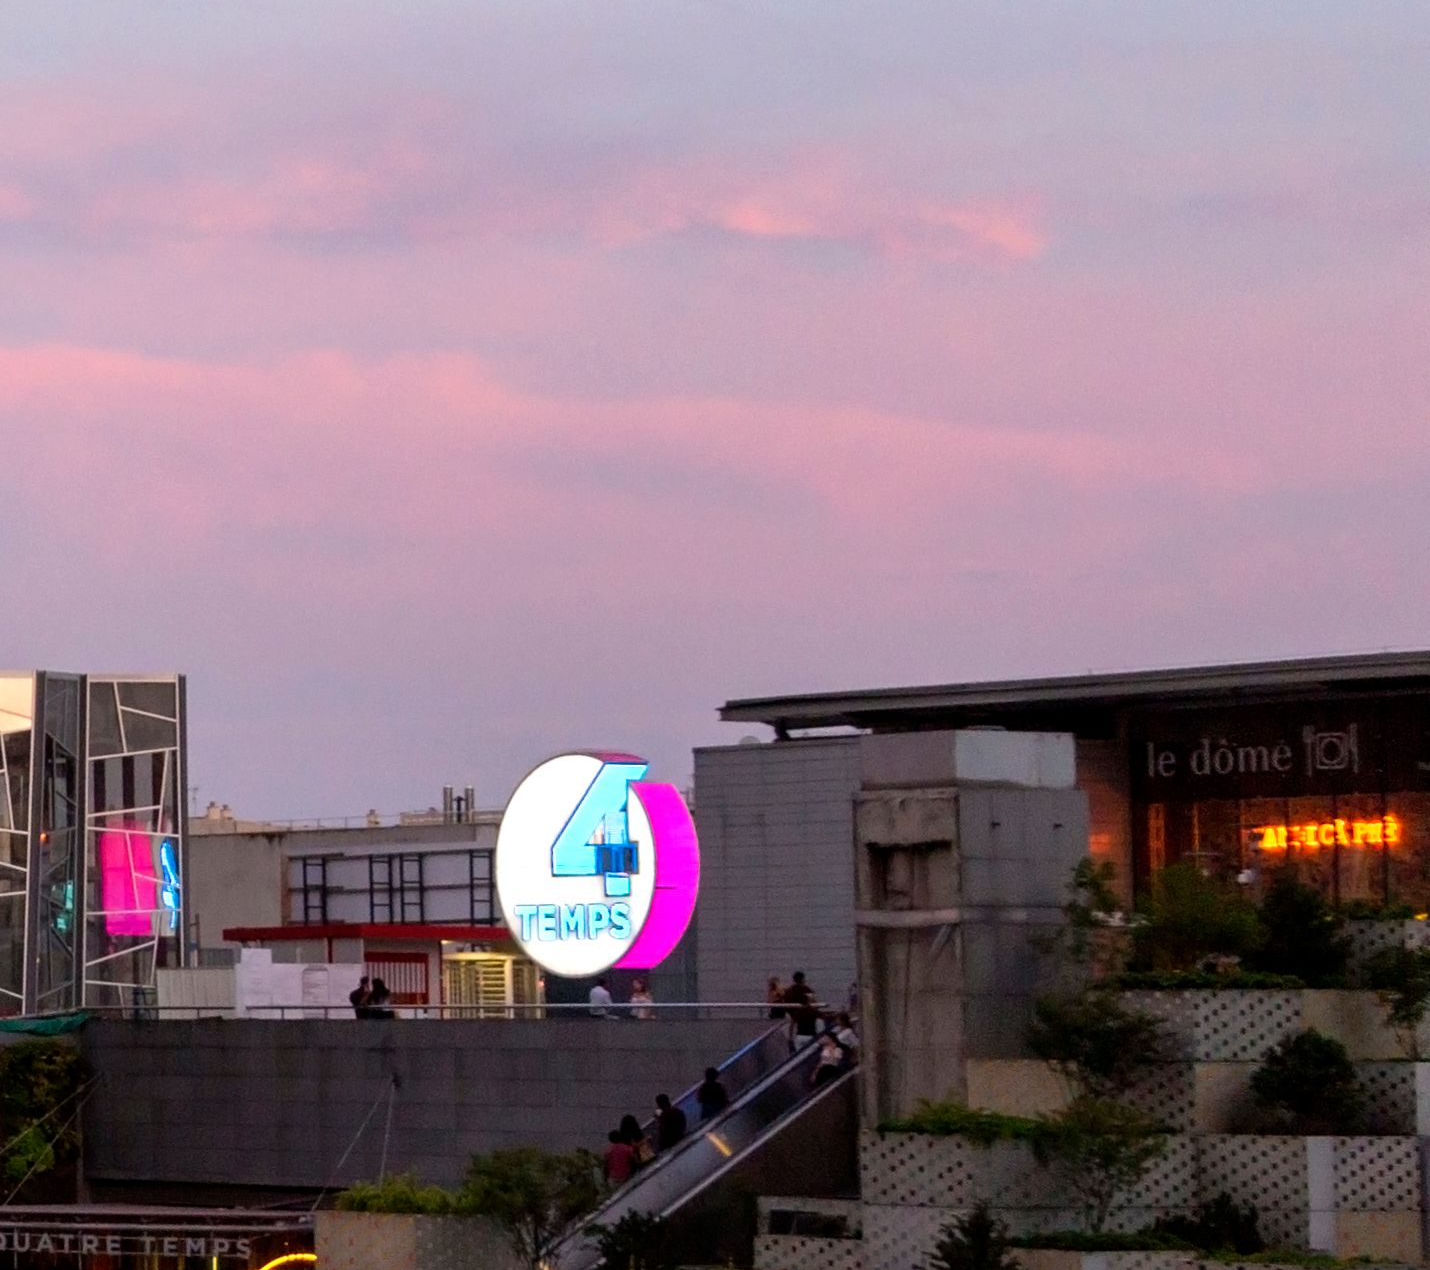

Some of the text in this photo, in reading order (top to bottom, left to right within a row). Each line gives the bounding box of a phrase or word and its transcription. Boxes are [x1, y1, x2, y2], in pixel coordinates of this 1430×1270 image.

[1146, 741, 1177, 778] le
[514, 902, 632, 942] TEMPS
[142, 1236, 253, 1260] TEMPS
